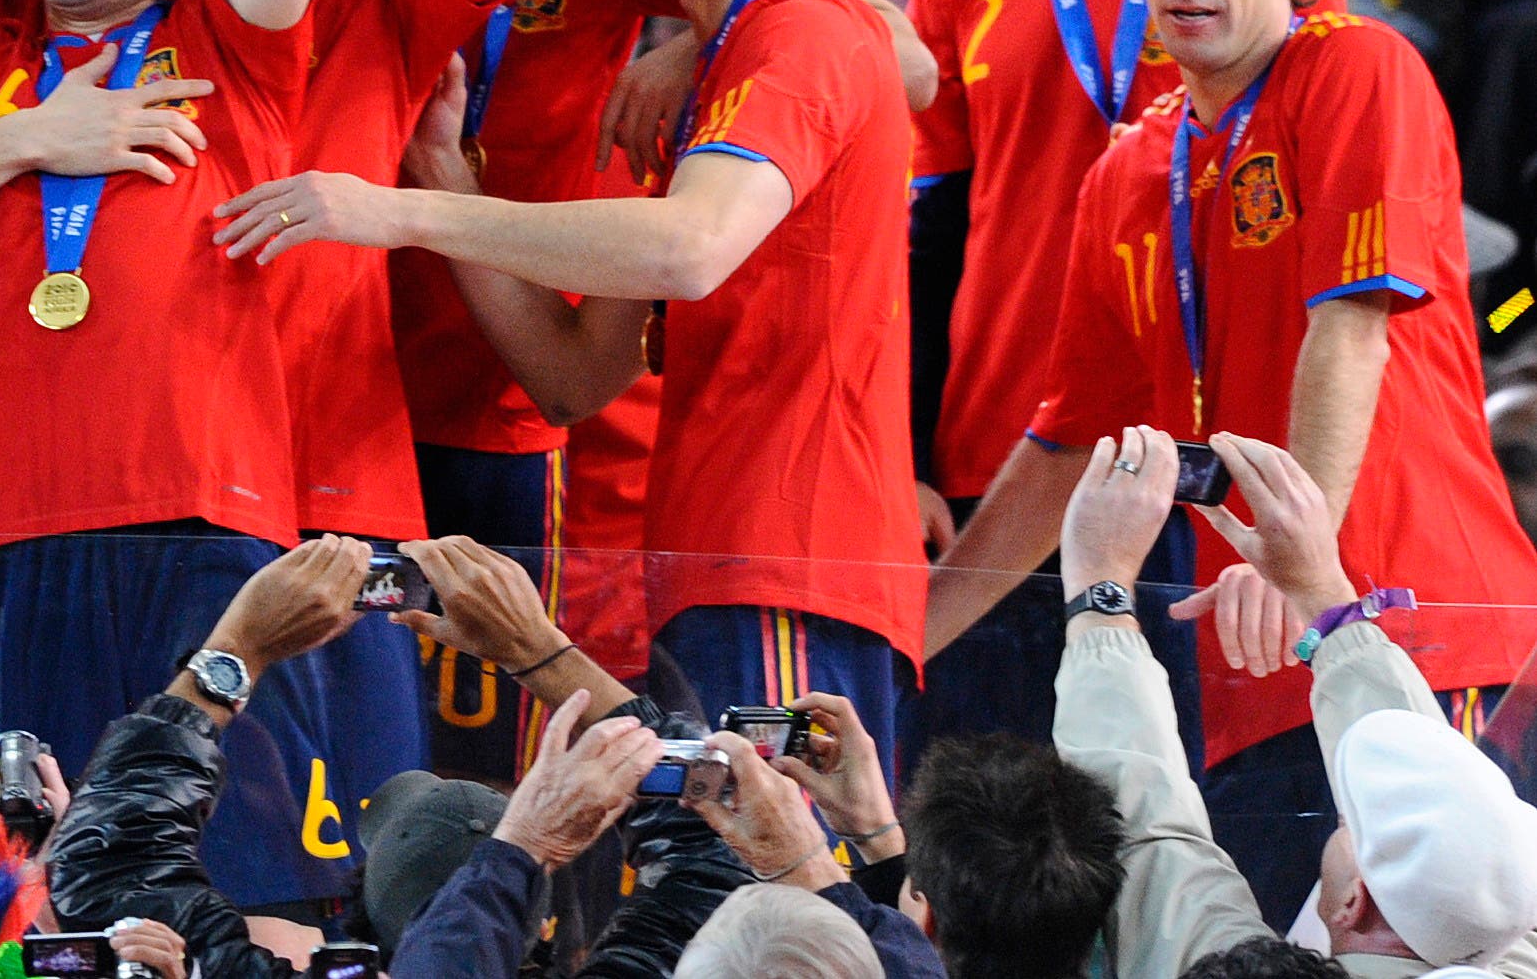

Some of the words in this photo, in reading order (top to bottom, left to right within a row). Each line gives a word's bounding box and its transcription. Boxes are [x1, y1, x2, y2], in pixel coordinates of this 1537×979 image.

[126, 31, 151, 54] FIFA
[1231, 113, 1251, 147] FIFA
[65, 204, 90, 236] FIFA
[1115, 232, 1158, 338] 11
[301, 757, 351, 859] 6
